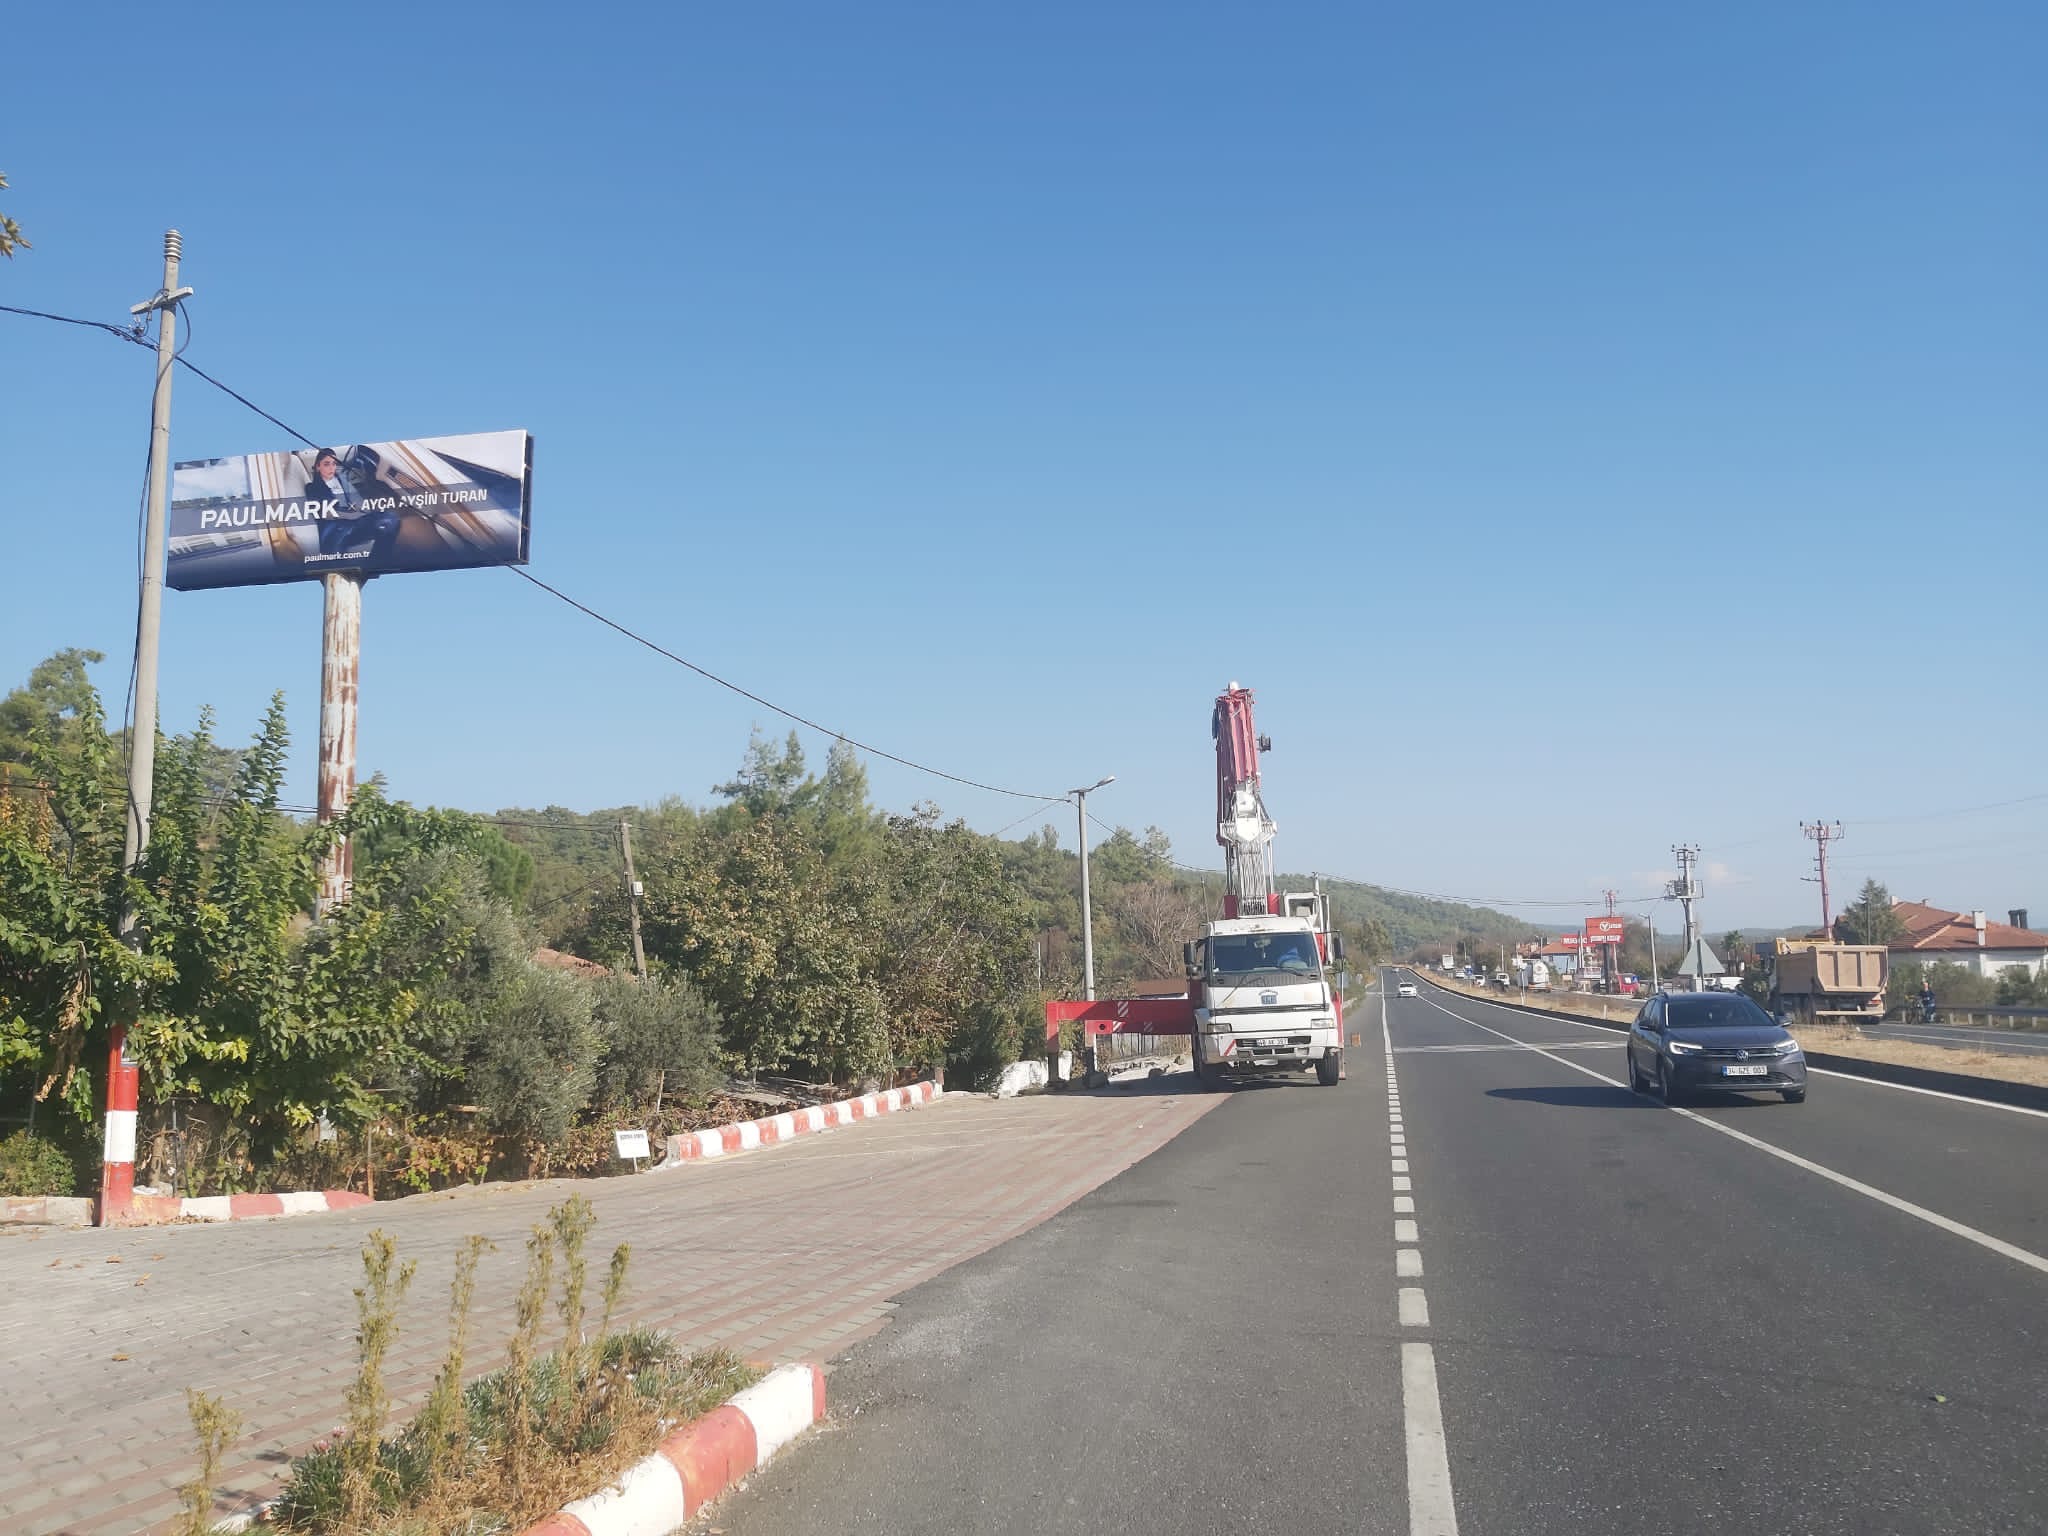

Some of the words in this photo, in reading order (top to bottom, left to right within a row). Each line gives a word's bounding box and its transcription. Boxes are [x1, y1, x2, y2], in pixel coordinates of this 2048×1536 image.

[200, 499, 340, 529] PAULMARK
[361, 497, 396, 512] AYÇA
[399, 491, 438, 508] AYŞİN
[441, 489, 488, 504] TURAN
[304, 551, 371, 563] paulmark.com.tr
